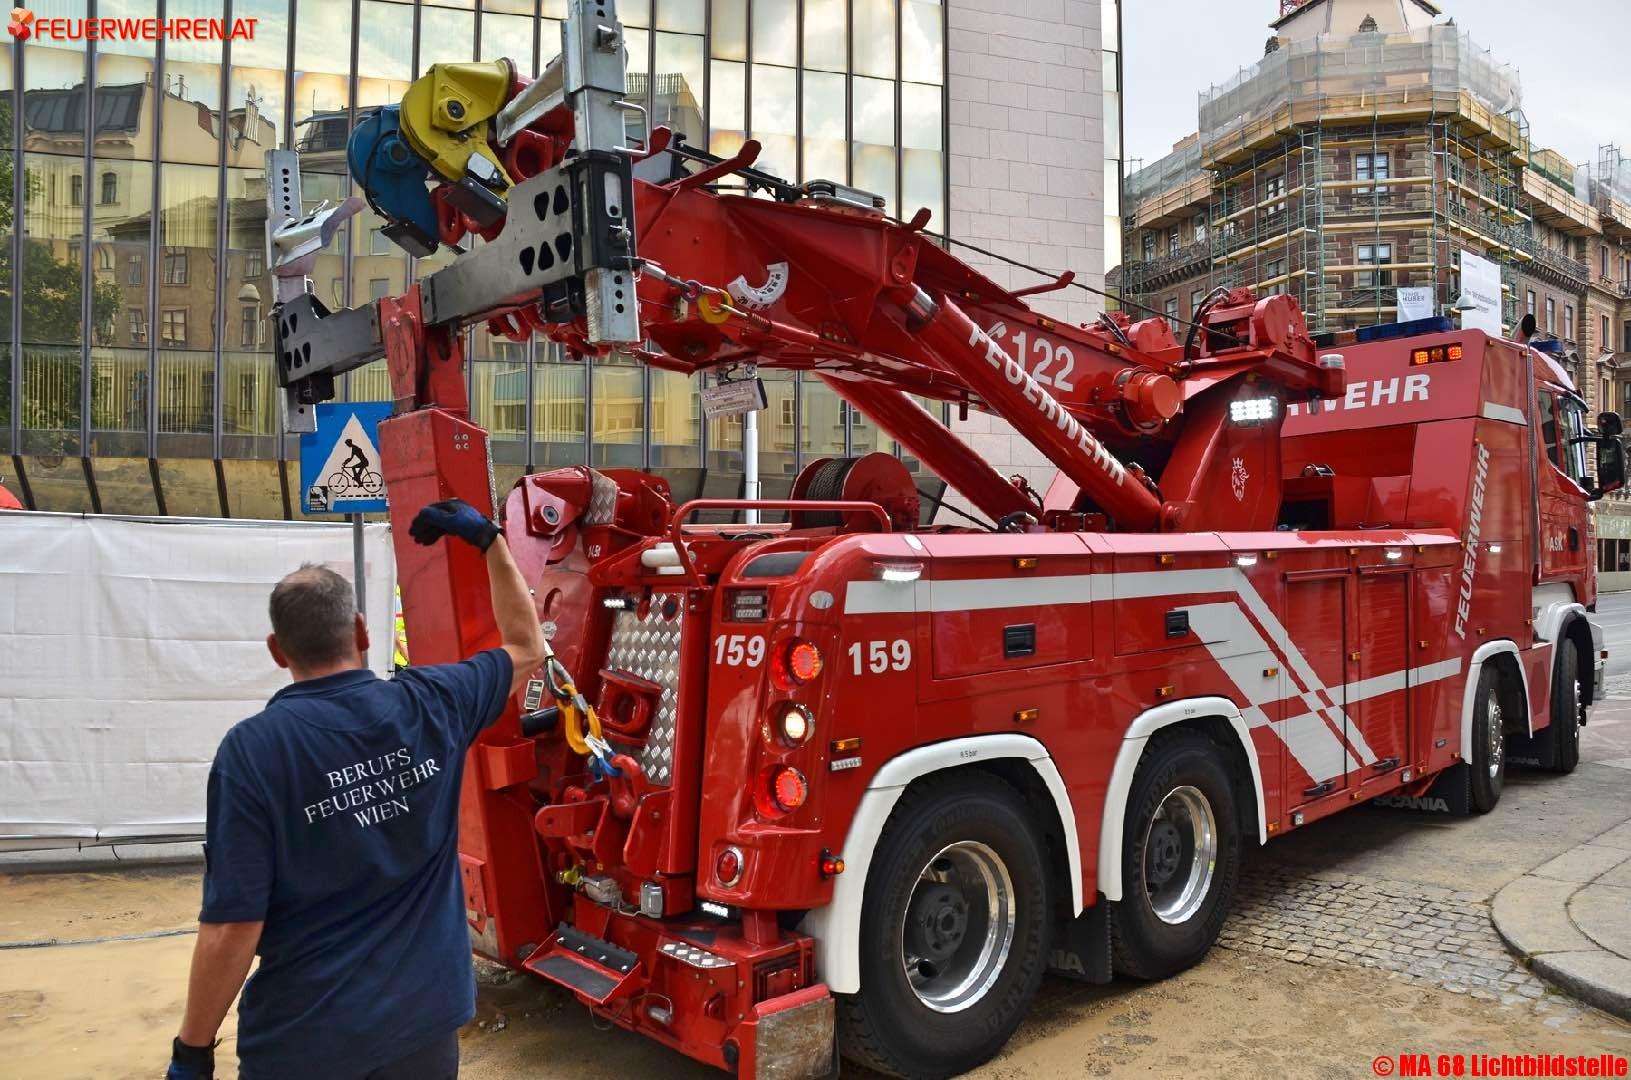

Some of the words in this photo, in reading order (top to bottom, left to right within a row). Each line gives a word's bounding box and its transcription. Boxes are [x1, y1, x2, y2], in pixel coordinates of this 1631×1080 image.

[1012, 331, 1075, 392] 122
[968, 323, 1126, 487] FEUERWEHR
[1455, 443, 1491, 641] FEUERWEHR
[714, 634, 766, 668] 159
[848, 639, 911, 676] 159
[304, 758, 441, 824] FEUERWEHR
[327, 747, 411, 789] BERUFS
[353, 796, 410, 828] WIEN
